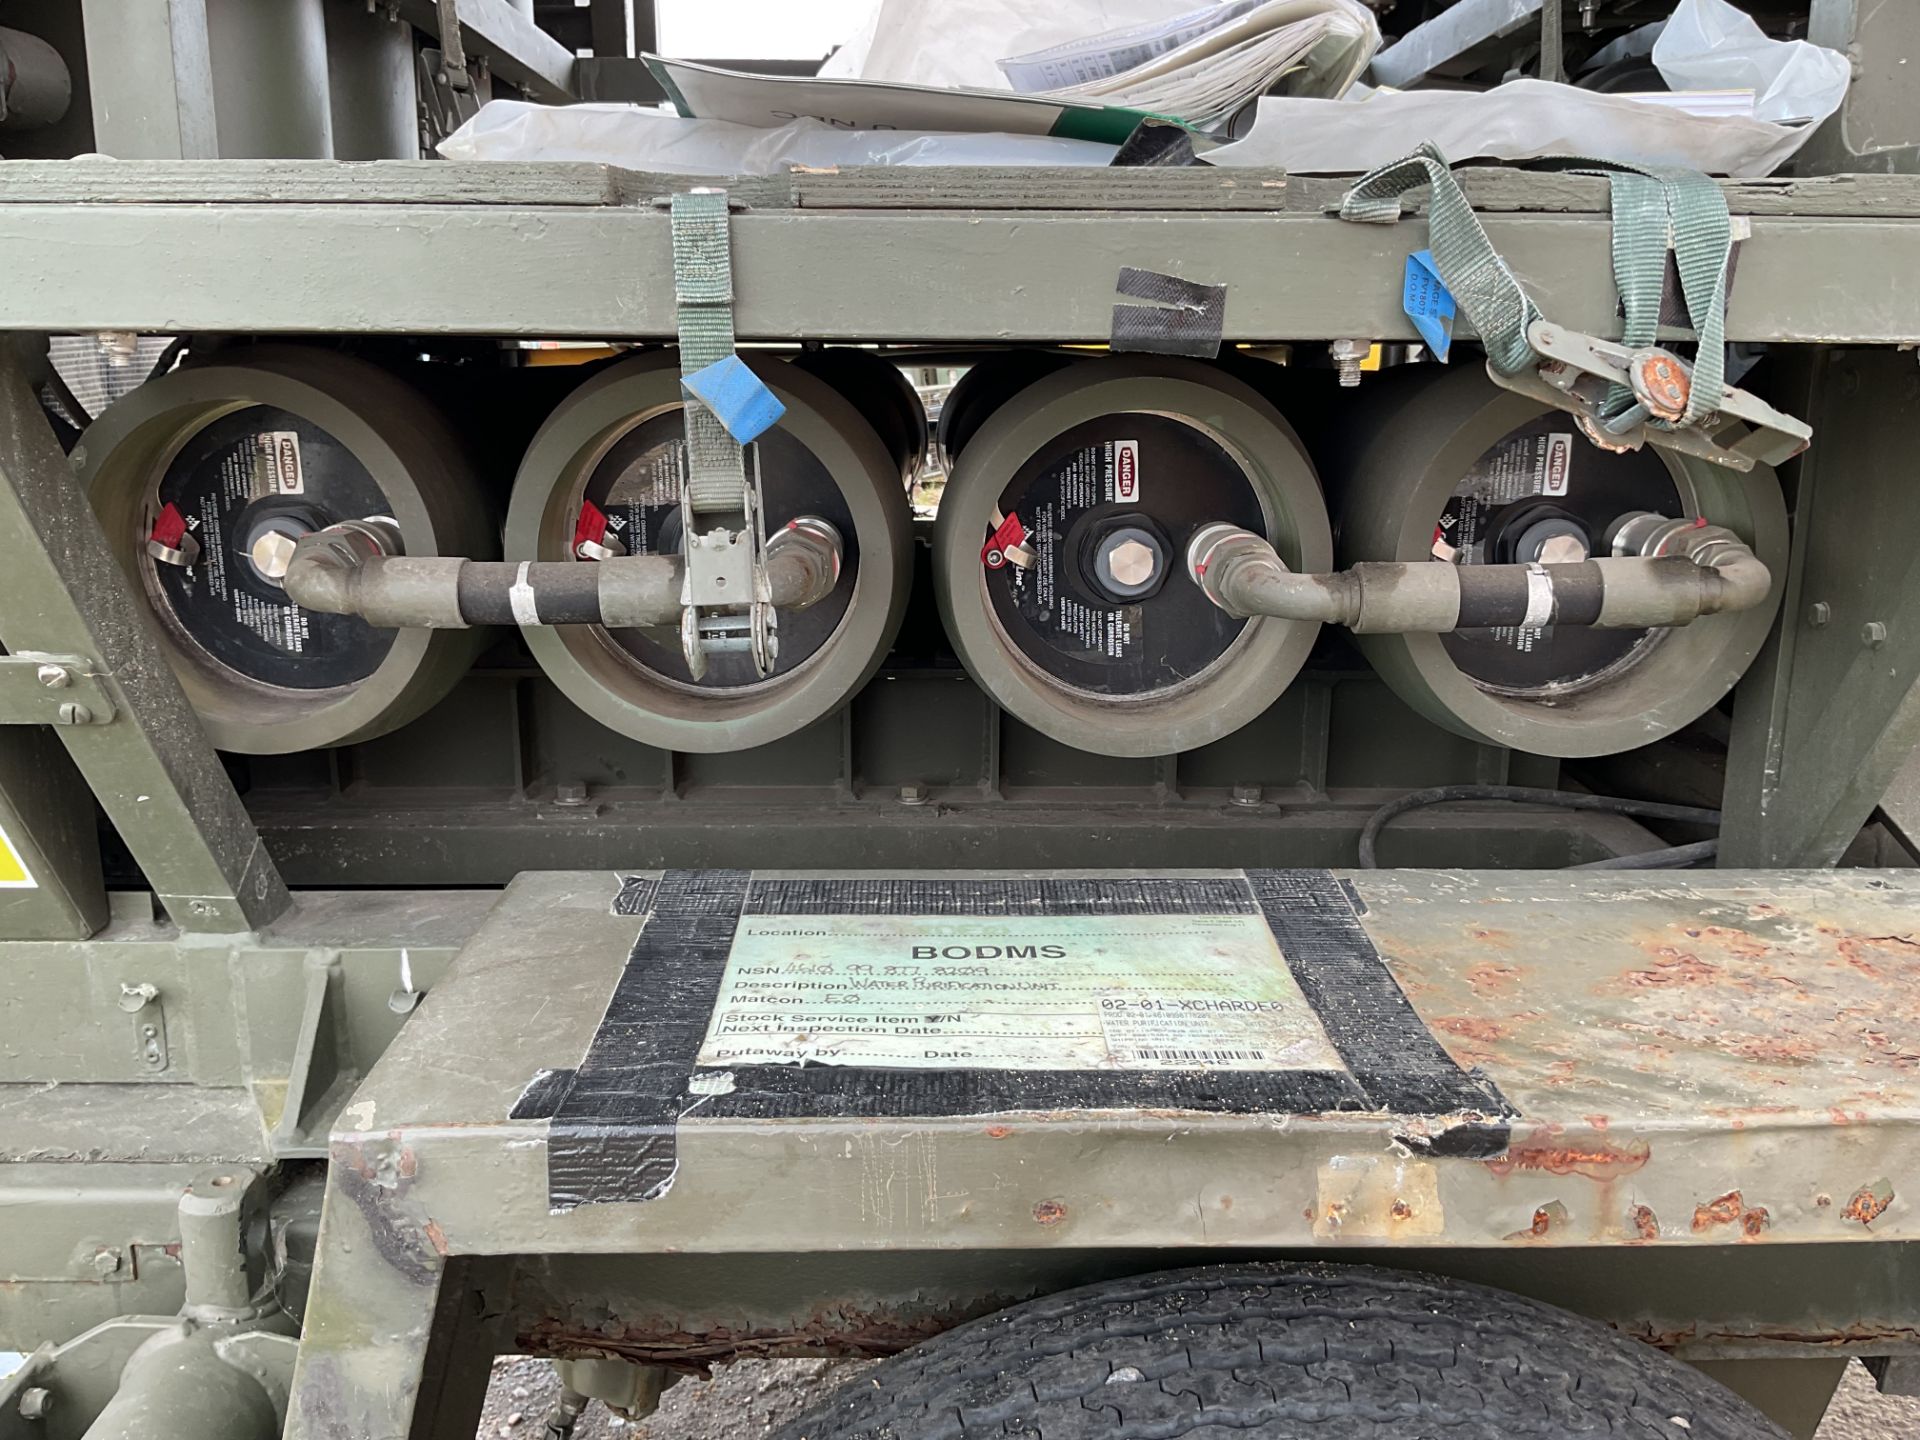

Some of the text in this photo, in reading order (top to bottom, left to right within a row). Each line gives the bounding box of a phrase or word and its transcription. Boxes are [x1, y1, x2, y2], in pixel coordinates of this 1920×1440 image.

[264, 435, 277, 493] HIGH PRESSURE
[282, 441, 295, 487] DANGER
[1533, 436, 1546, 494] HIGH PRESSURE
[1551, 443, 1564, 487] DANGER
[1105, 444, 1113, 501] HIGH PRESSURE
[1122, 450, 1131, 494] DANGER
[211, 493, 219, 518] REVERSE
[217, 545, 225, 575] MEMBRANE
[291, 604, 300, 633] TOLERATE
[301, 617, 308, 625] DO
[1108, 613, 1114, 621] OR
[283, 606, 294, 650] OR CORROSION
[1123, 623, 1129, 631] DO
[1525, 634, 1533, 652] LEAKS
[747, 929, 827, 937] Location
[912, 945, 1067, 959] BODMS
[738, 966, 779, 975] NSN
[734, 980, 848, 990] Description
[849, 976, 907, 990] WATER
[912, 976, 1015, 990] PURIFICATION
[730, 995, 803, 1004] Matcon
[724, 1014, 785, 1023] Stock
[791, 1015, 868, 1024] Service
[876, 1015, 918, 1024] Item
[722, 1025, 942, 1035] Next Inspection Date
[815, 1048, 841, 1058] by
[924, 1050, 973, 1059] Date
